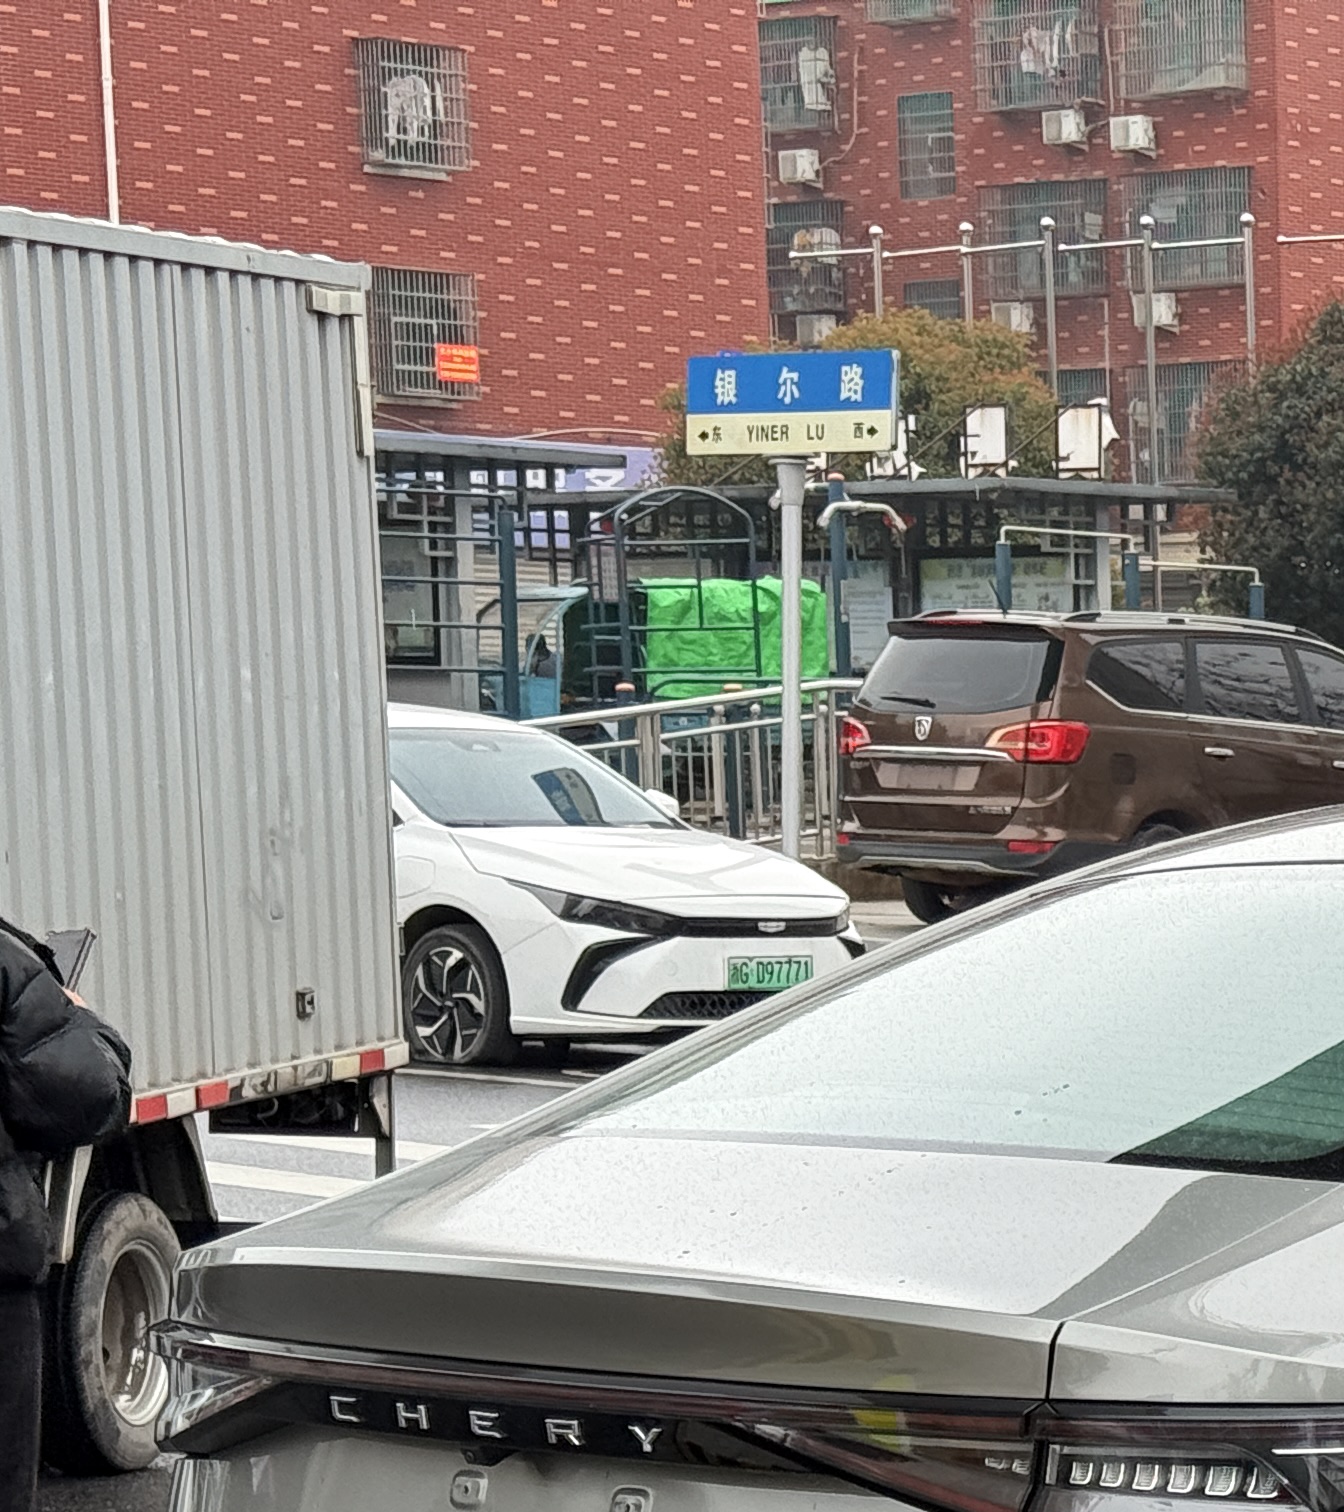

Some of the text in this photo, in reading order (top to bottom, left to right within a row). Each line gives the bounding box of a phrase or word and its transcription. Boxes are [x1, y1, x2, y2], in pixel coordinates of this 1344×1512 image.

[714, 363, 864, 406] 银尔路
[711, 421, 865, 443] 东 YINER LU 西
[329, 1395, 663, 1453] CHERY
